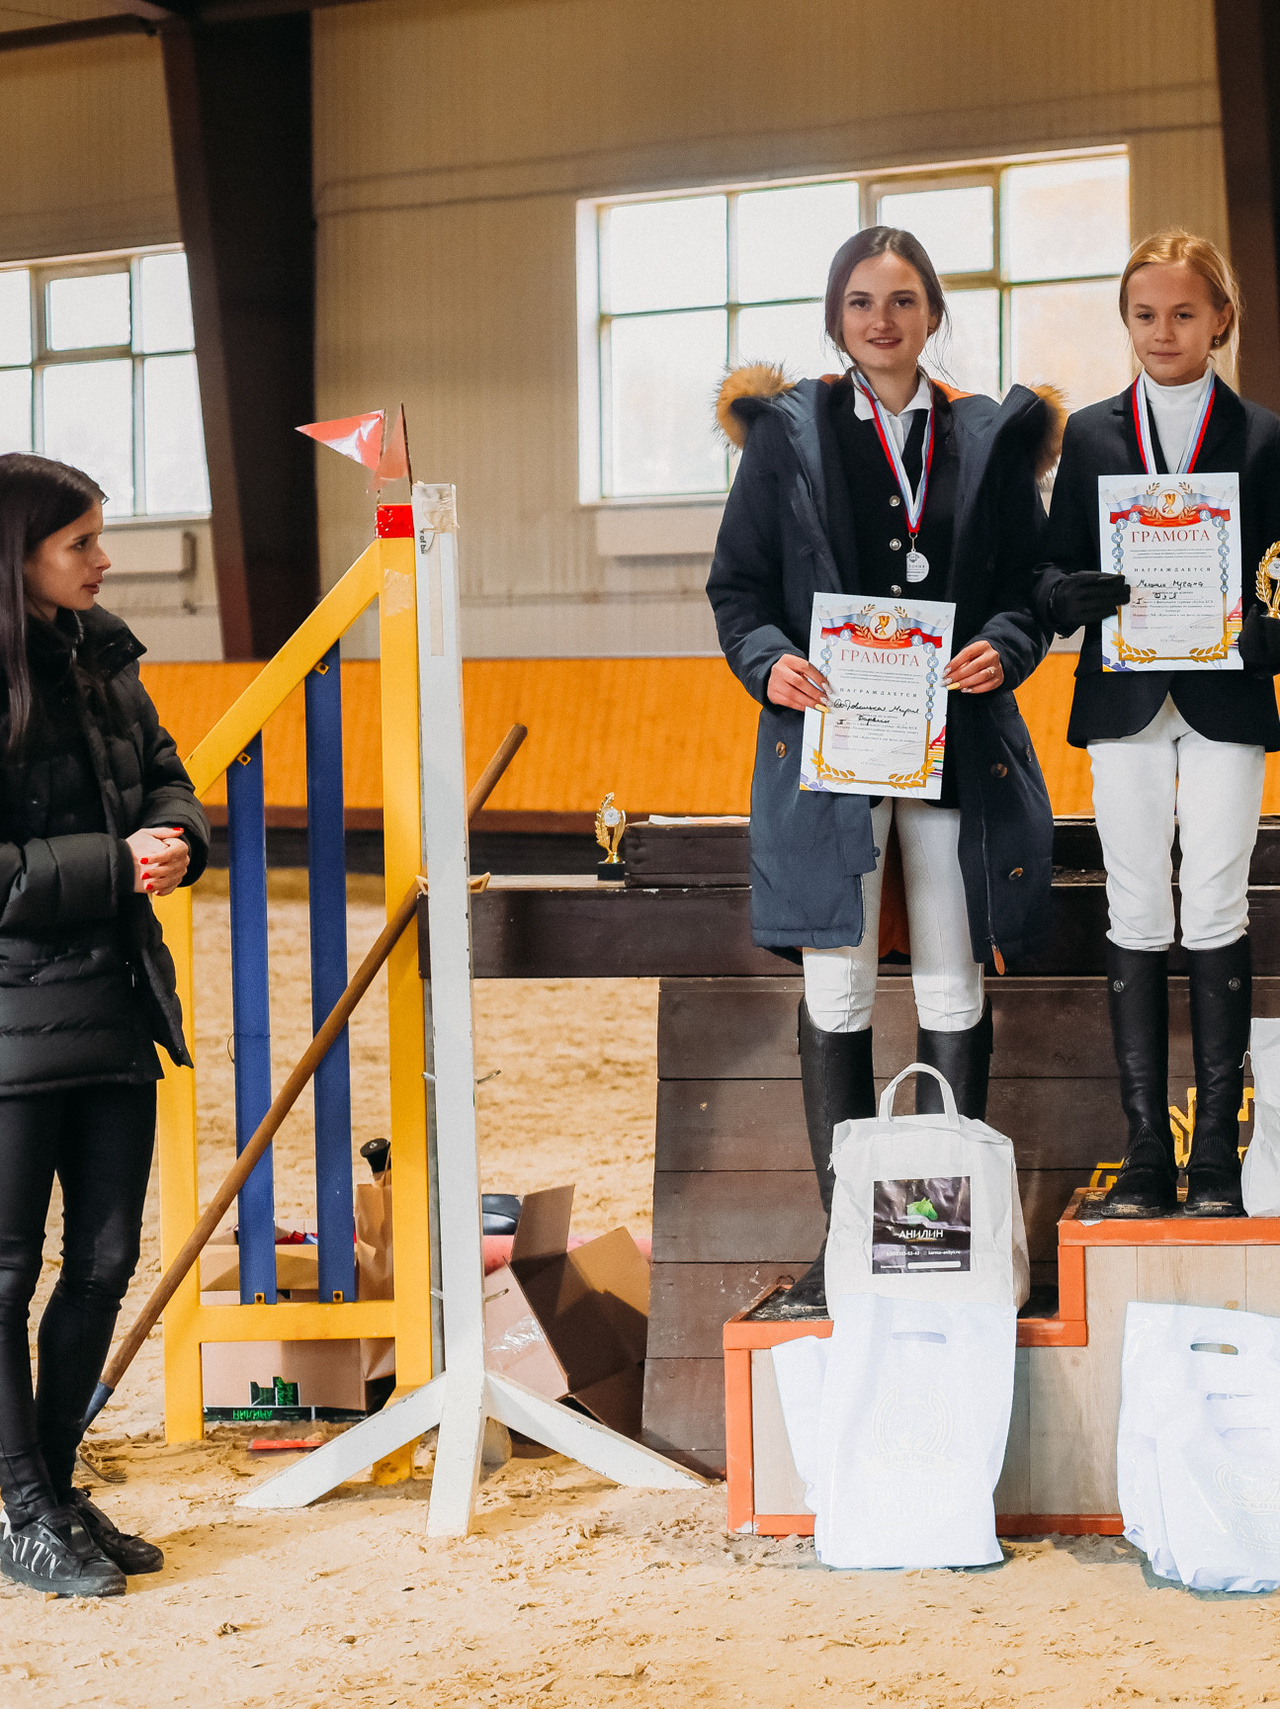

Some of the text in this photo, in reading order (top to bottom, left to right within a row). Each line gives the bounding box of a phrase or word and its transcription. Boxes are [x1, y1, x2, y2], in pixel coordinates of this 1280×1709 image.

[1131, 529, 1211, 543] ГРАМОТА
[841, 649, 920, 667] ГРАМОТА
[839, 687, 918, 699] НАГРАЖДАЕТСЯ
[899, 1229, 944, 1239] АНИЛИН
[9, 1535, 63, 1580] VLTN
